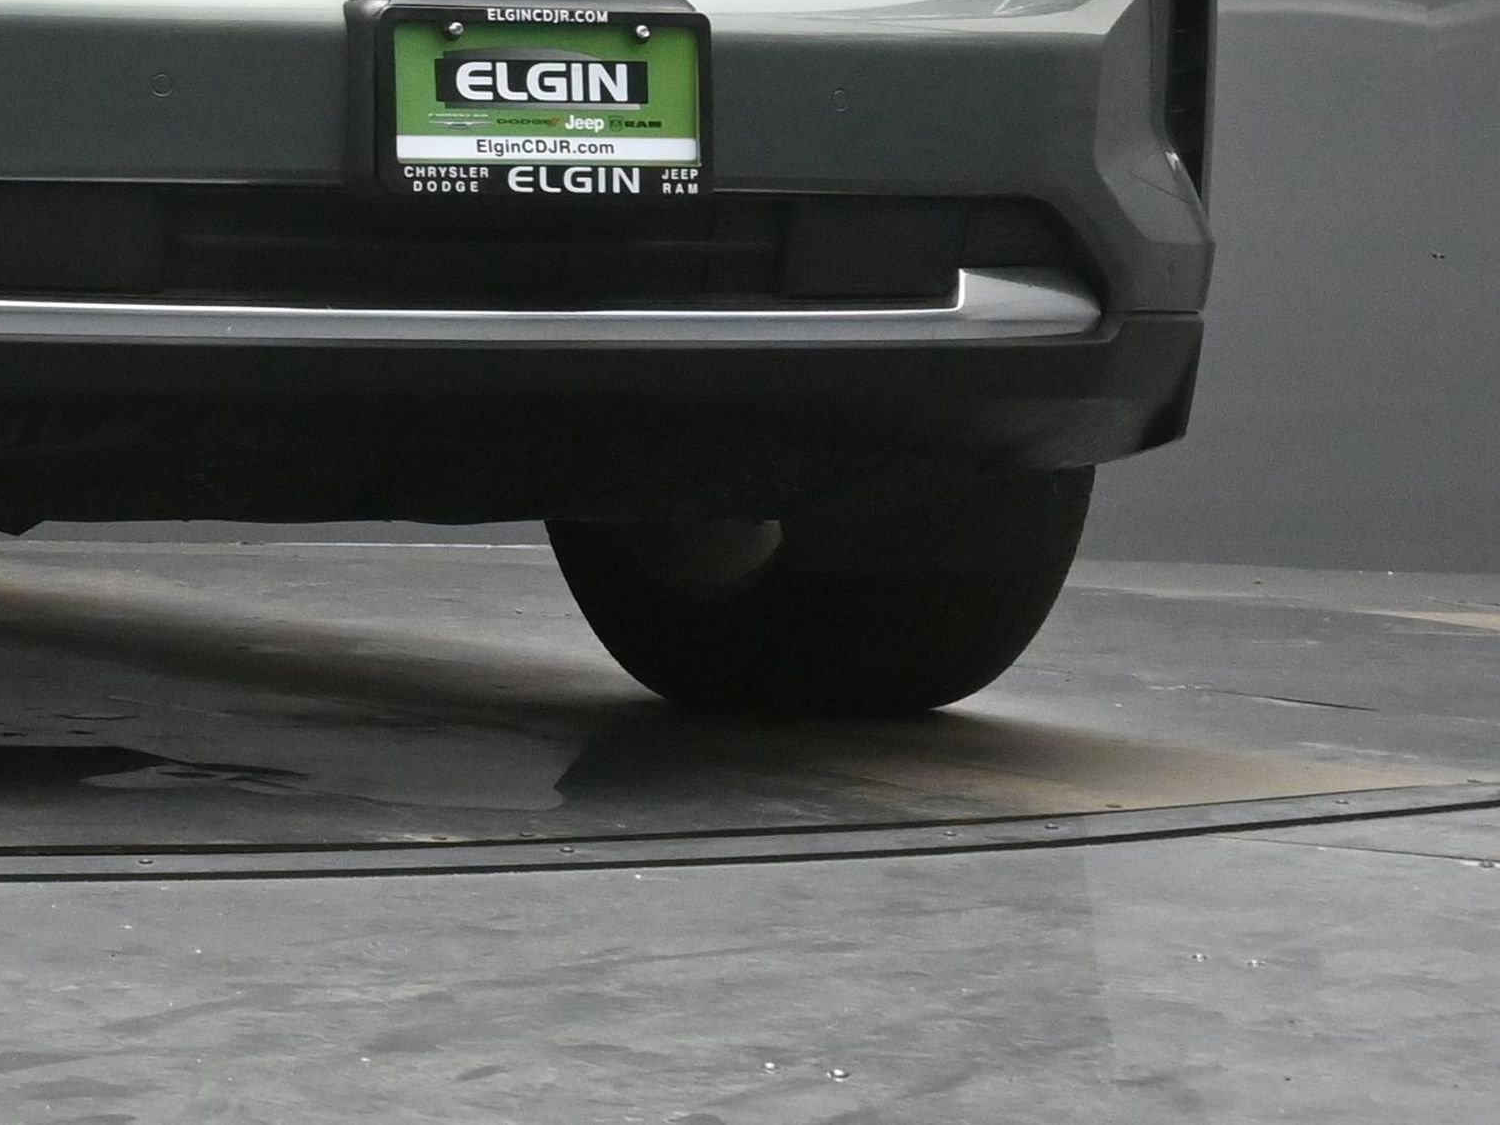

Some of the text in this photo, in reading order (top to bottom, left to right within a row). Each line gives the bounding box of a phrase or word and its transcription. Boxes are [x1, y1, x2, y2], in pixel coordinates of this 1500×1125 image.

[487, 8, 609, 24] ELGINCDJR.COM
[455, 61, 629, 102] ELGIN
[564, 114, 605, 133] Jeep
[476, 139, 615, 157] ElginCDJR.com
[403, 165, 489, 179] CHRYSLER
[507, 166, 640, 194] ELGIN
[661, 168, 699, 181] JEEP
[412, 180, 480, 193] DODGE
[662, 182, 699, 195] RAM
